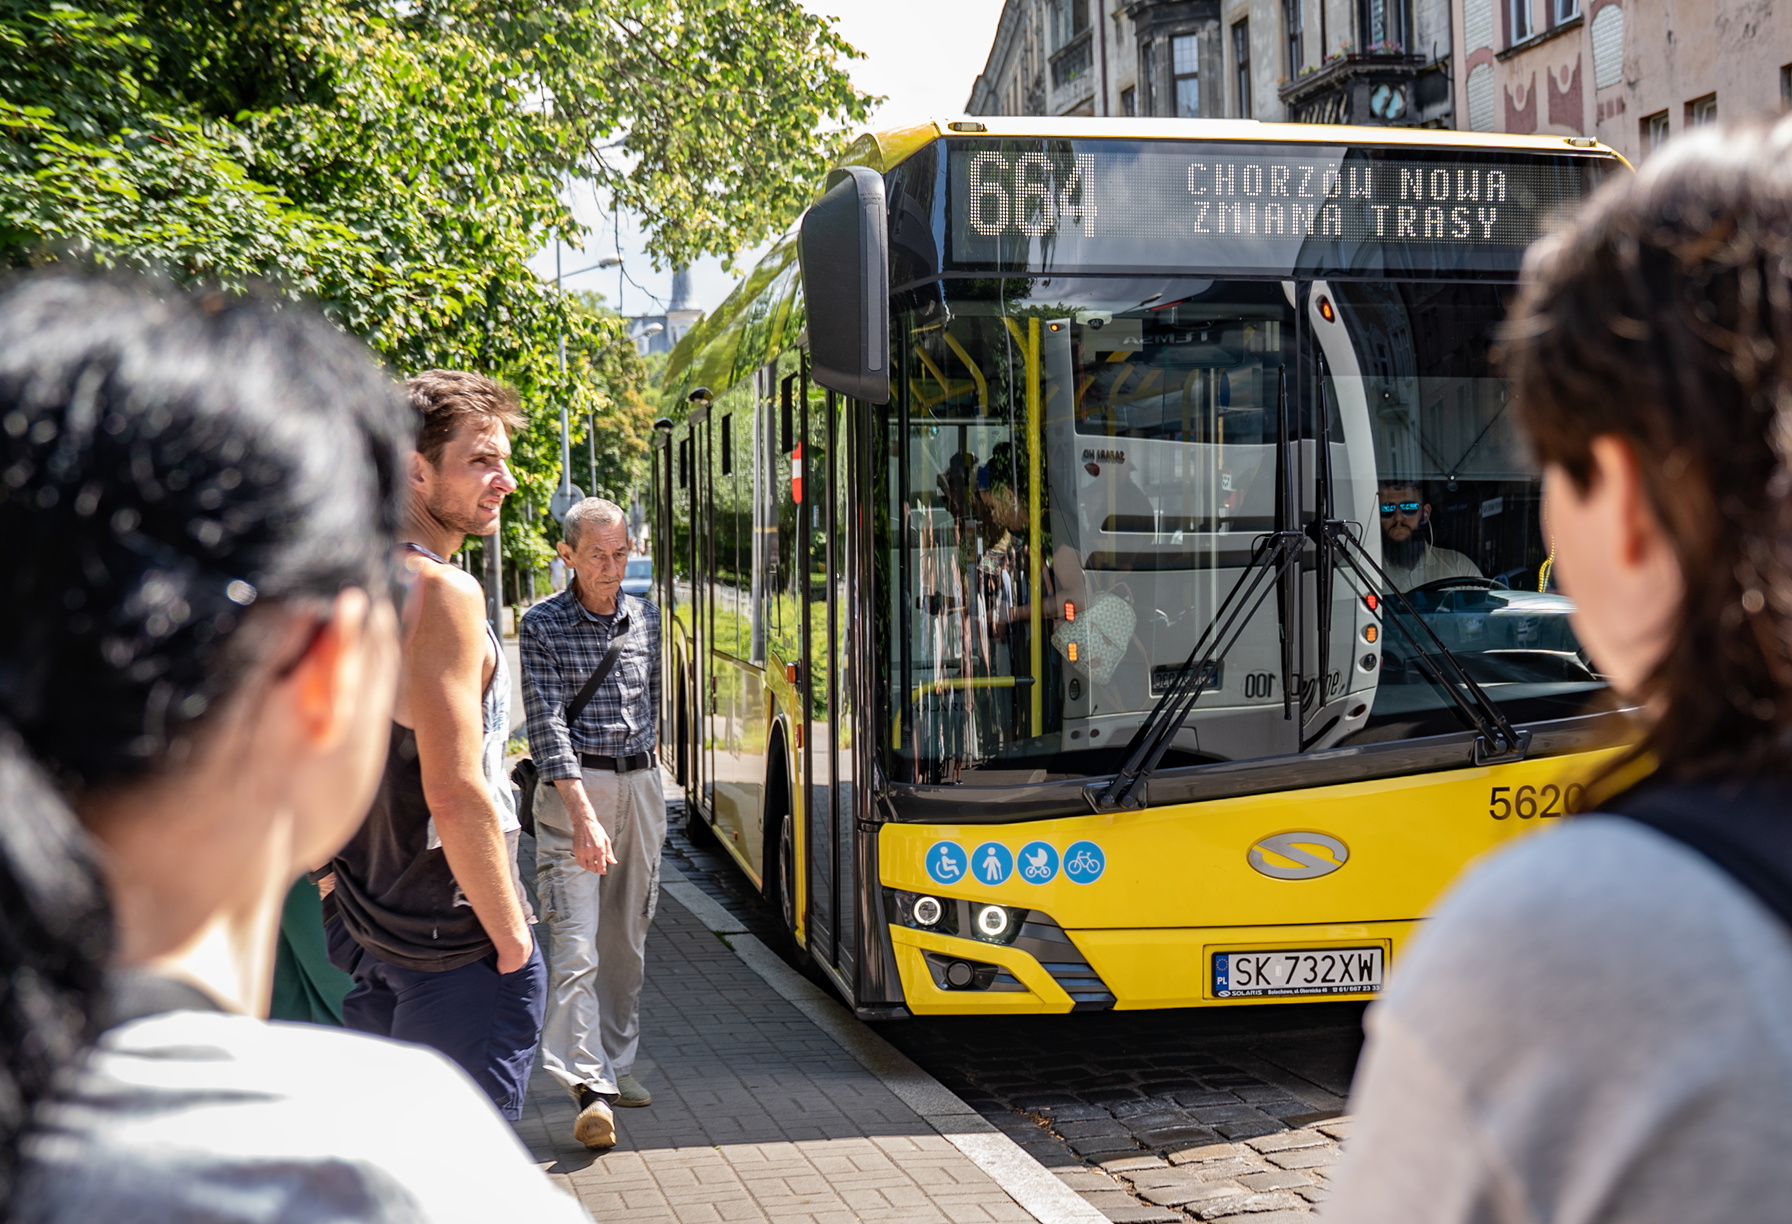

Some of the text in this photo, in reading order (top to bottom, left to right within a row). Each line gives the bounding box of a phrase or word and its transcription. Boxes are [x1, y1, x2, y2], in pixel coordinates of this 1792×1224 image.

[970, 151, 1097, 238] 664
[1188, 163, 1505, 201] CHORZÓW NOWA
[1194, 201, 1496, 238] ZMIANA TRASY
[1489, 782, 1586, 820] 5620
[1217, 977, 1228, 985] PL
[1236, 953, 1374, 986] SK 732XW
